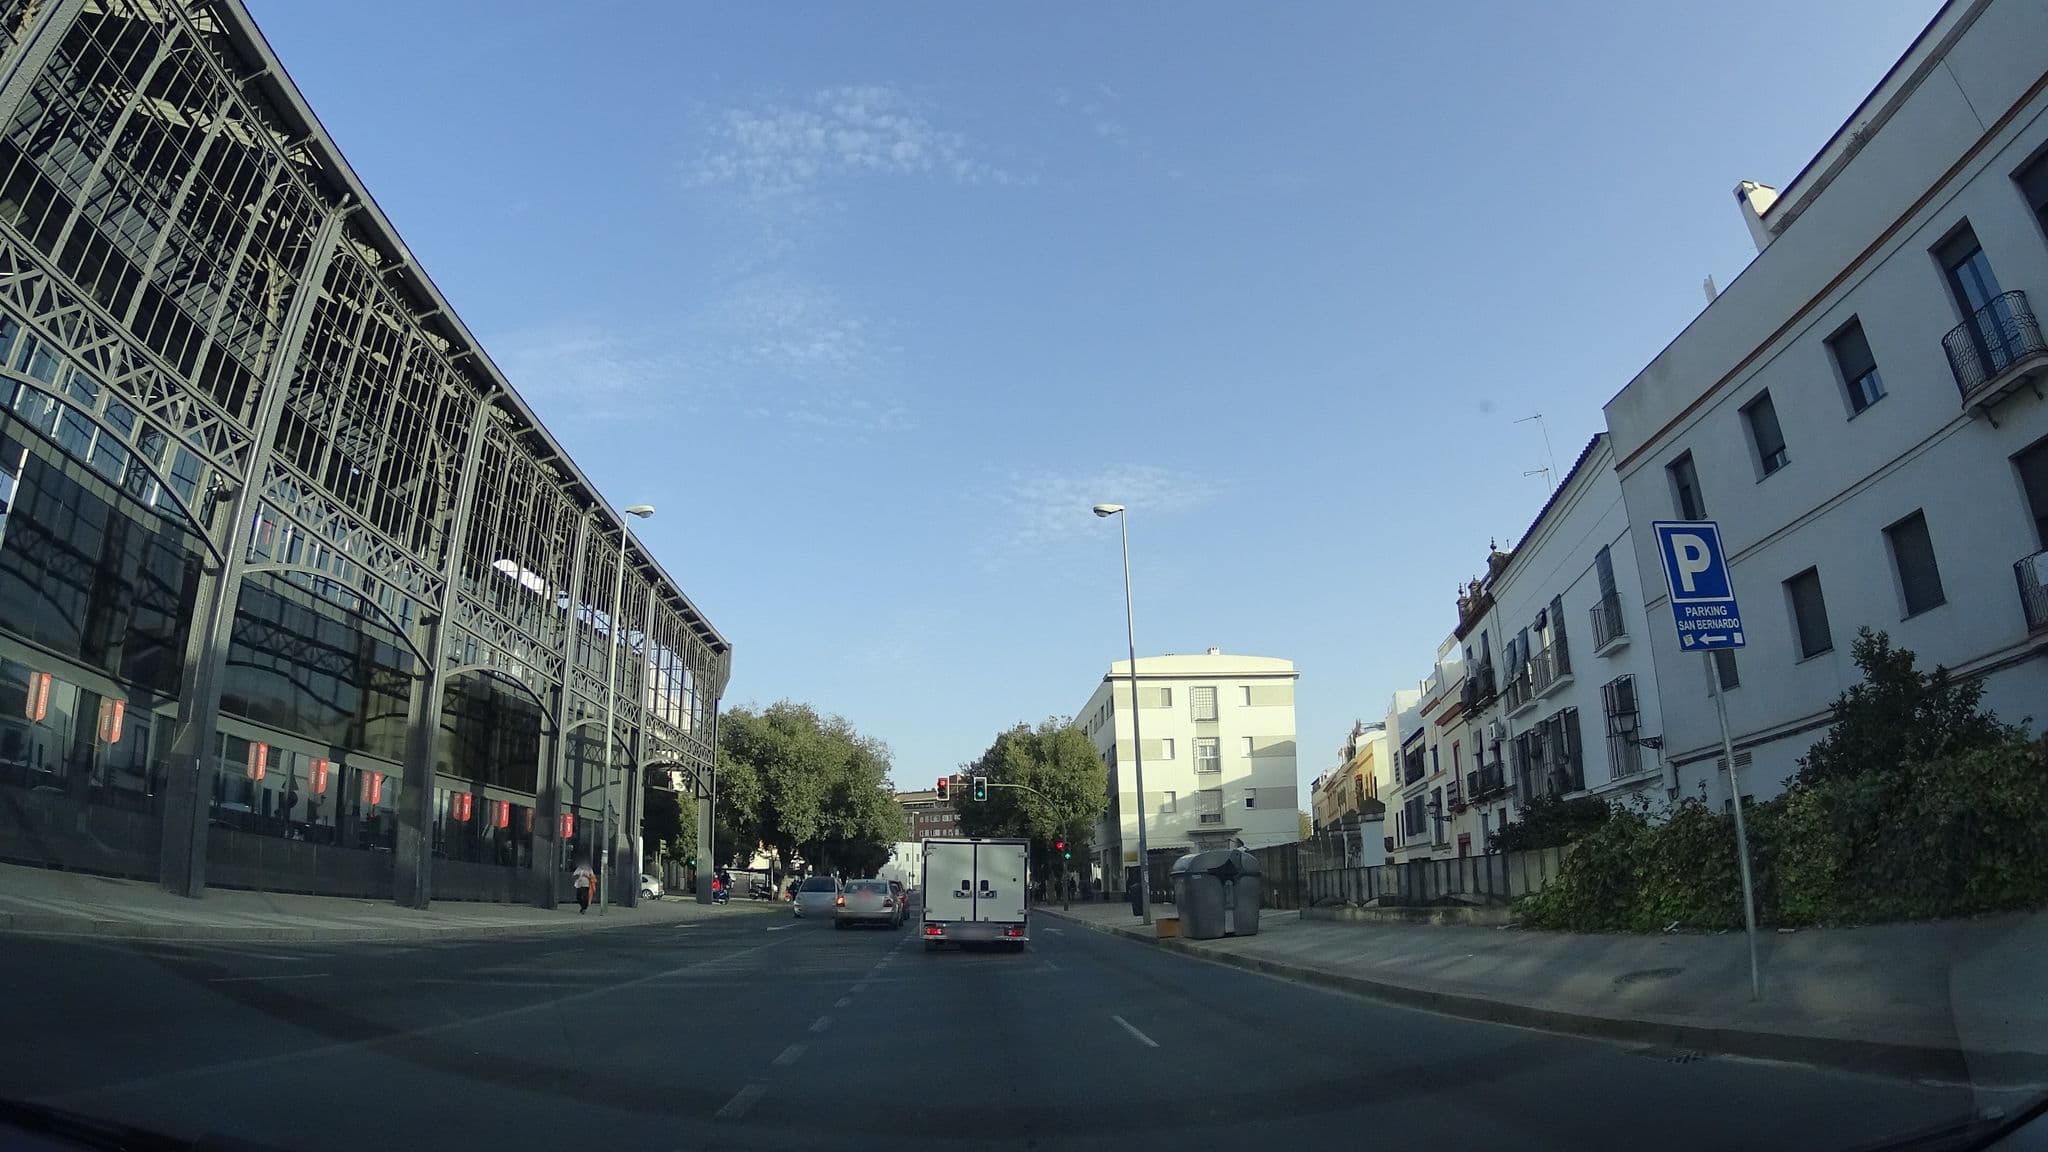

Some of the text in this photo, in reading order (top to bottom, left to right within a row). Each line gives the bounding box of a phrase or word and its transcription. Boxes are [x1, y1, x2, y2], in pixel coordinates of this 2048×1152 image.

[1670, 533, 1711, 592] P
[1685, 605, 1728, 617] PARKING
[1678, 618, 1740, 631] SAN BERNARDO
